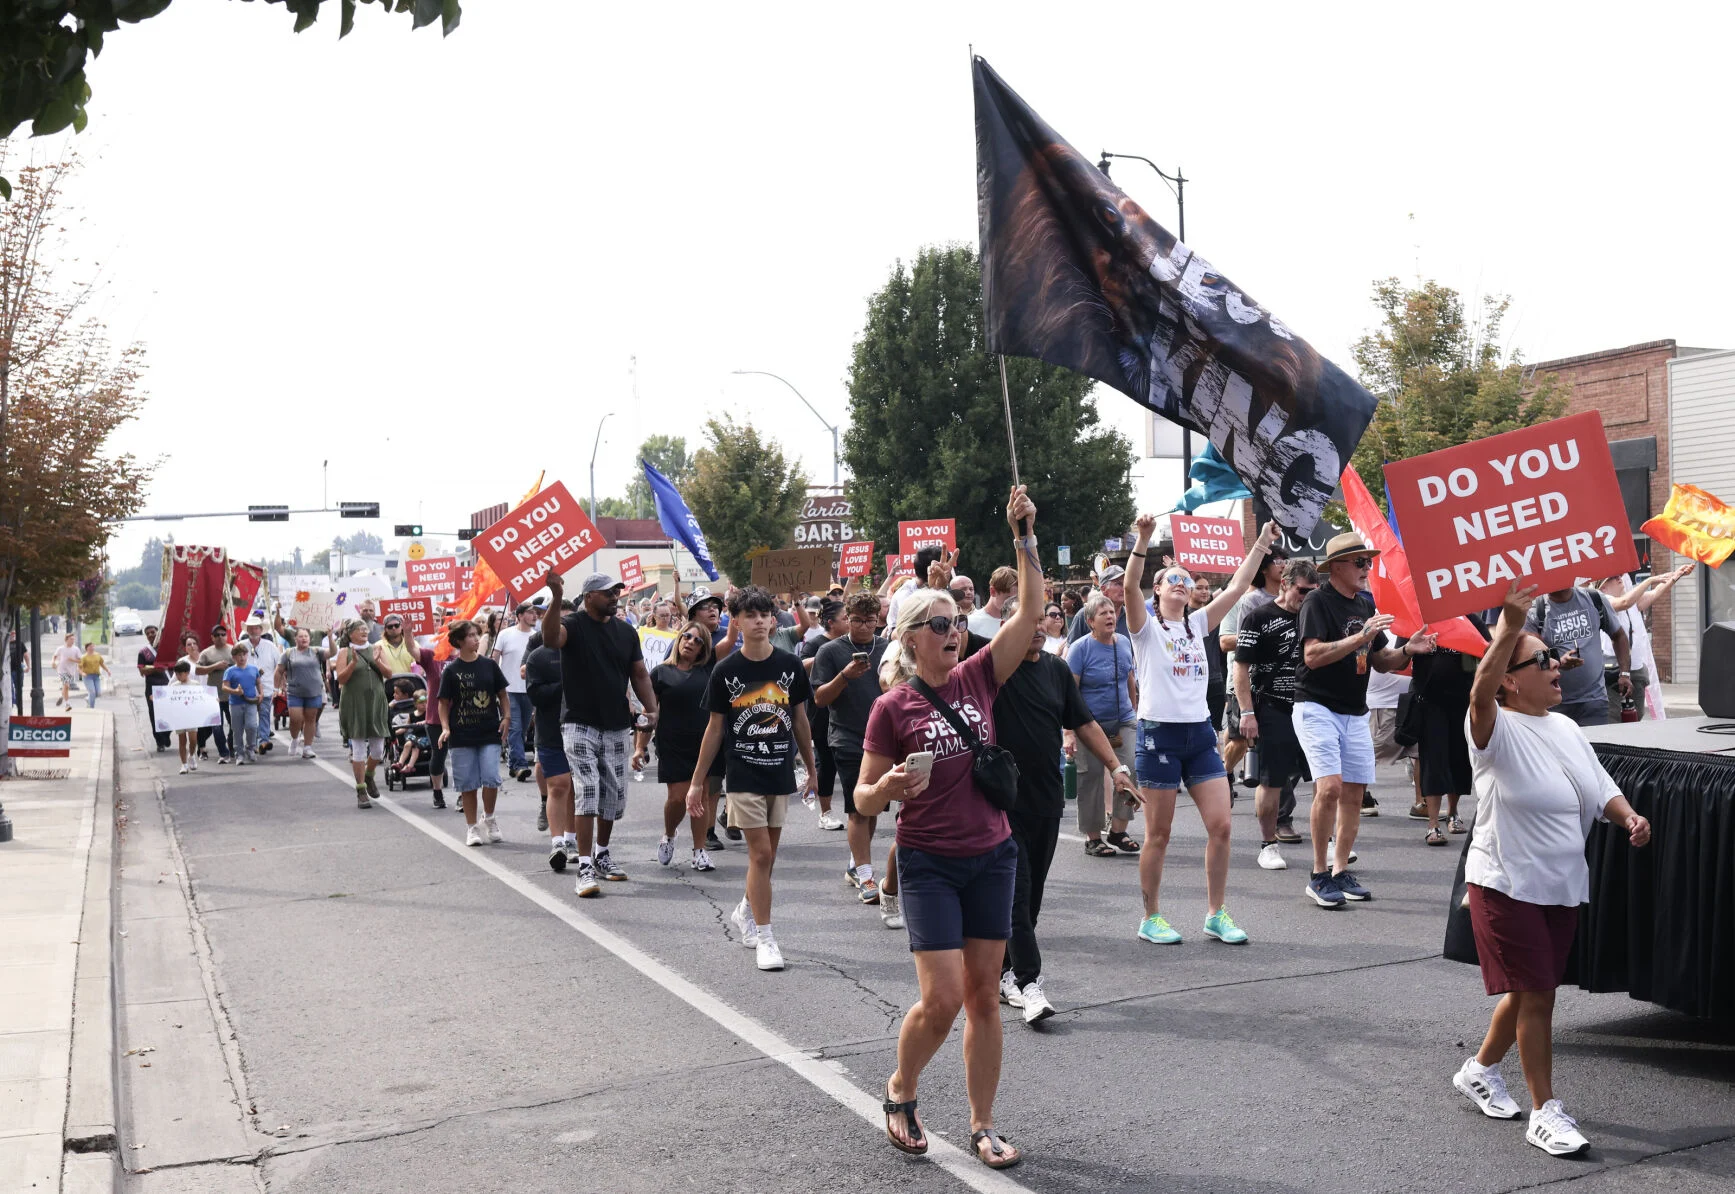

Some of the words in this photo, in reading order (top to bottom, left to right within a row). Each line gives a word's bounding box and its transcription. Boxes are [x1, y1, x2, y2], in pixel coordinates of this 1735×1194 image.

[1149, 322, 1340, 540] KING
[1417, 467, 1478, 507] DO
[1488, 438, 1580, 486] YOU
[798, 498, 855, 519] Lariat
[489, 527, 519, 552] DO
[518, 496, 561, 530] YOU
[1453, 492, 1569, 545] NEED
[906, 527, 922, 537] DO
[925, 525, 949, 535] YOU
[1180, 522, 1200, 533] DO
[1203, 524, 1233, 536] YOU
[512, 522, 564, 563] NEED
[1190, 538, 1228, 550] NEED
[846, 545, 869, 554] JESUS
[510, 528, 592, 592] PRAYER?
[756, 556, 800, 568] JESUS
[813, 556, 826, 567] IS
[845, 555, 868, 564] LOVES
[1179, 552, 1242, 567] PRAYER?
[1426, 525, 1617, 600] PRAYER?
[412, 564, 427, 572] DO
[429, 562, 450, 570] YOU
[846, 565, 864, 574] YOU!
[419, 572, 446, 582] NEED
[768, 570, 812, 586] KING!
[411, 582, 455, 593] PRAYER?
[387, 601, 424, 612] JESUS
[1555, 614, 1588, 633] JESUS
[1553, 625, 1592, 644] FAMOUS
[645, 637, 666, 653] GOD
[1172, 653, 1190, 663] SHE
[751, 703, 777, 713] OVER
[12, 730, 67, 741] DECCIO
[746, 724, 778, 736] Blessed
